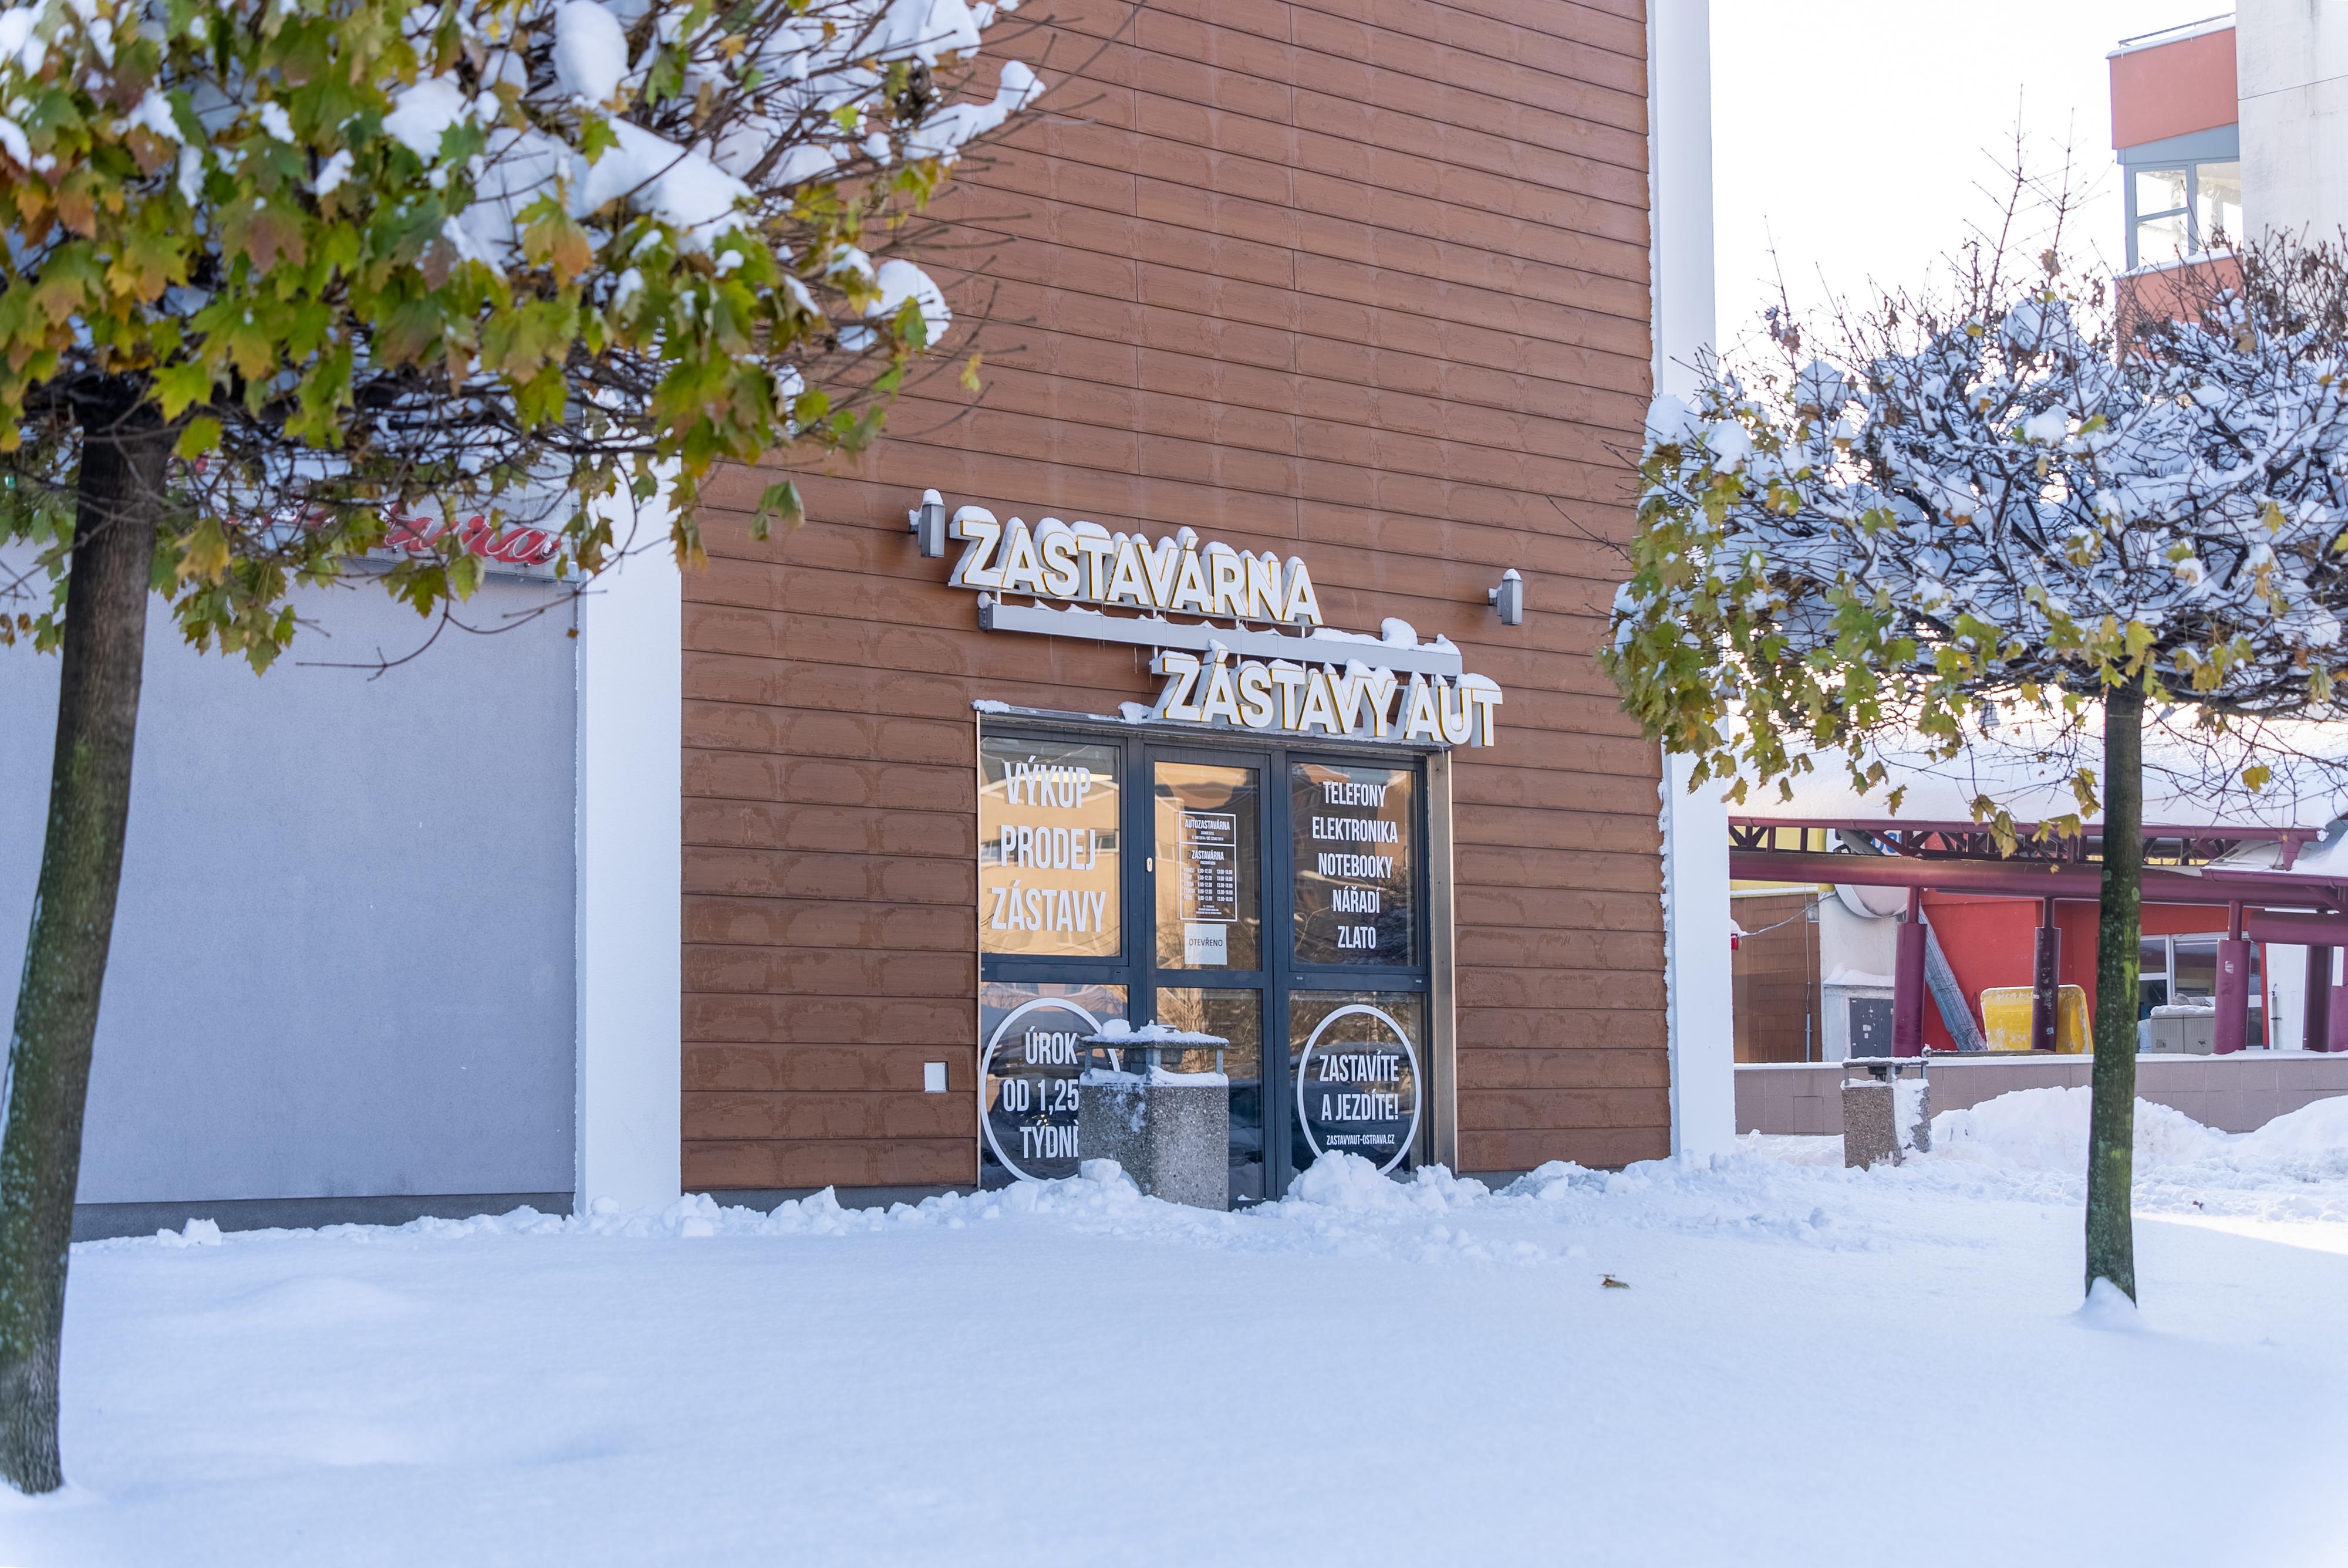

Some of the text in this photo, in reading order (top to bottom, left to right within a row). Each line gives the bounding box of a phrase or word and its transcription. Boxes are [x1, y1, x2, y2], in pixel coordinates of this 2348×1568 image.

[957, 519, 1324, 626] ZASTAVÁRNA
[1162, 648, 1503, 748] ZÁSTAVY AUT
[1004, 755, 1091, 808] VÝKUP
[1323, 781, 1386, 807] TELEFONY
[1185, 819, 1230, 830] AUTOZASTAVÁRNA
[1312, 816, 1398, 843] ELEKTRONIKA
[1000, 824, 1096, 871] PRODEJ
[1191, 849, 1224, 861] ZASTAVÁRNA
[1318, 853, 1393, 878] NOTEBOOKY
[991, 879, 1106, 932] ZÁSTAVY
[1332, 886, 1380, 913] NÁŘADÍ
[1189, 937, 1223, 947] OTEVŘENO
[1337, 925, 1377, 949] ZLATO
[1025, 1026, 1078, 1065] ÚROK
[1320, 1050, 1399, 1082] ZASTAVÍTE
[1003, 1079, 1079, 1115] OD 1,25
[1321, 1089, 1398, 1121] A JEZDÍTE!
[1327, 1134, 1395, 1145] ZASTAVYAUT-OSTRAVA.CZ
